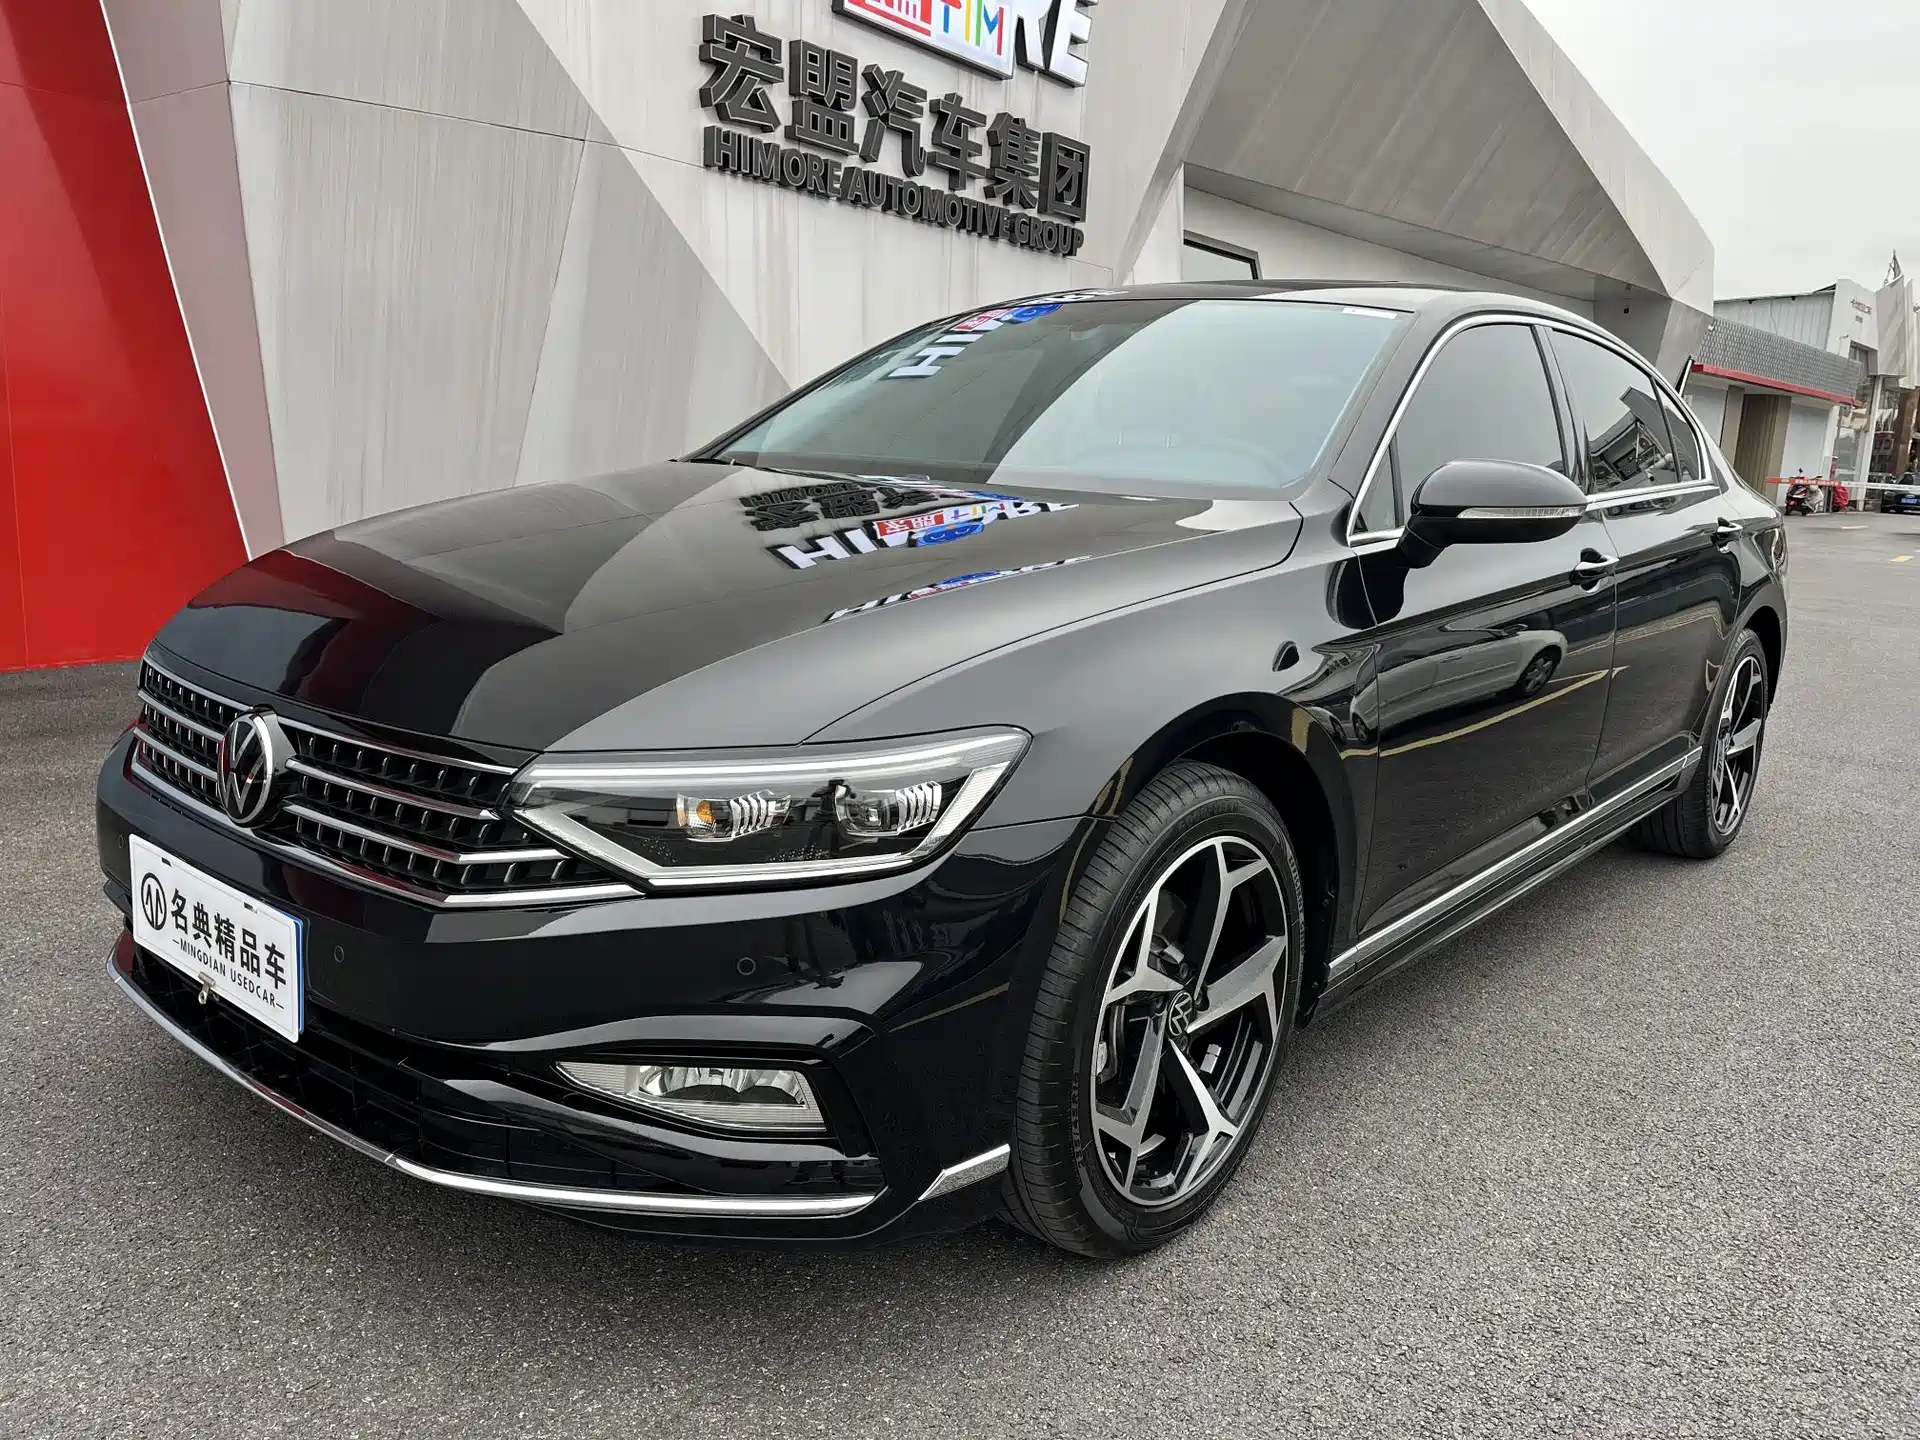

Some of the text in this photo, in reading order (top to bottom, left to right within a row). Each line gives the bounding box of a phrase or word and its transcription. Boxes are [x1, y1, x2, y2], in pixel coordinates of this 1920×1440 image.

[699, 14, 1091, 223] 宏盟汽车集团
[704, 125, 1084, 256] HIMORE AUTOMOTIVE GROUP
[171, 888, 286, 989] 名典精品车
